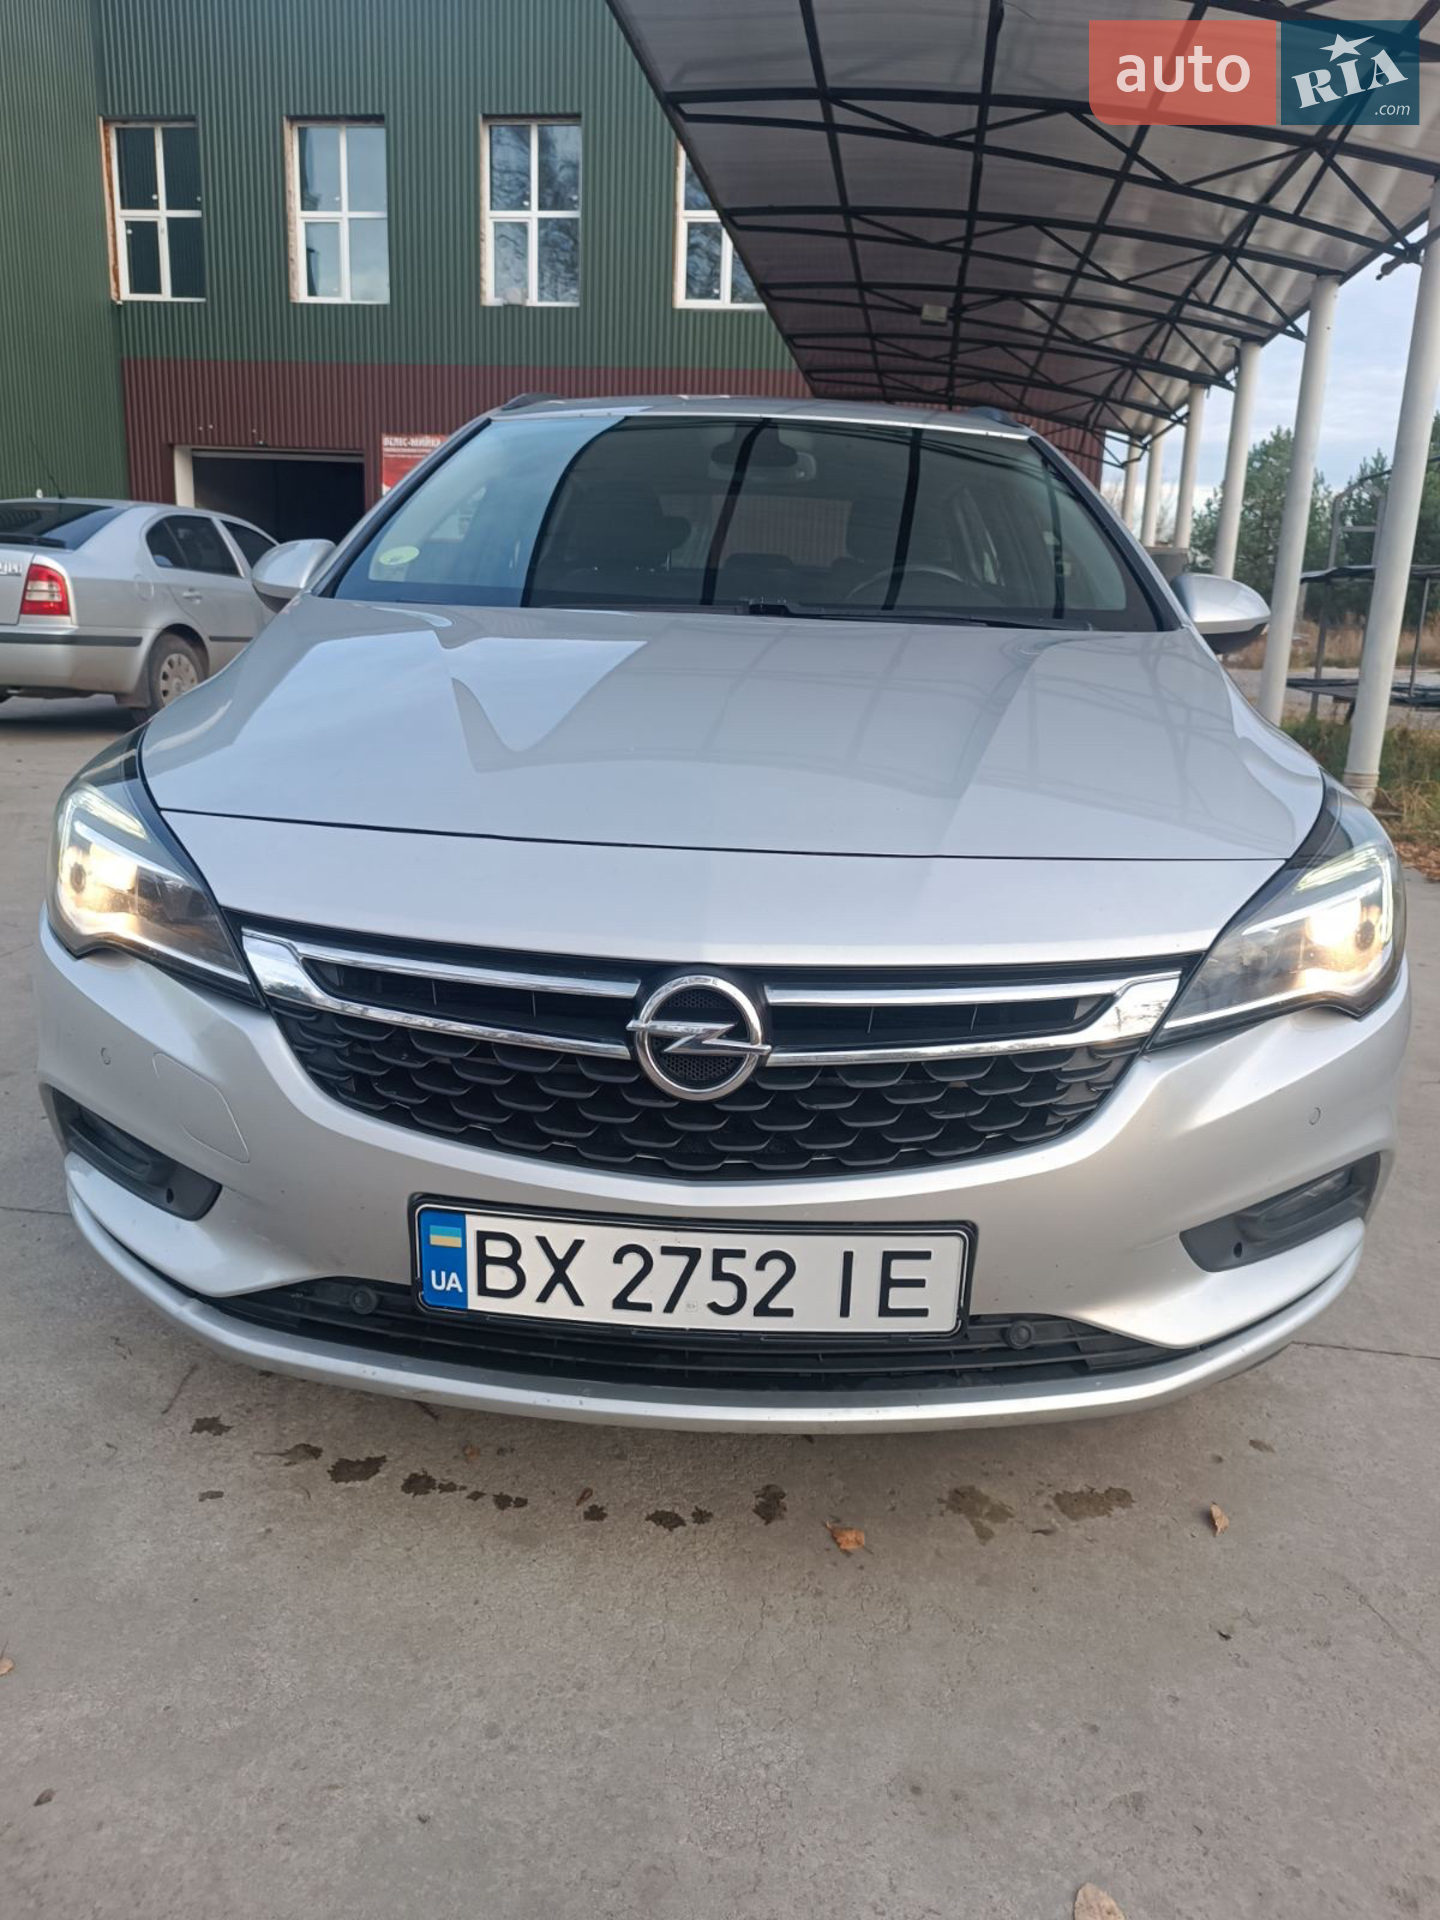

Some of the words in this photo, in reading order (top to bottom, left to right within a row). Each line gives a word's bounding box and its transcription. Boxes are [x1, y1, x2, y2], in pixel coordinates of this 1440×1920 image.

[431, 1269, 464, 1293] UA
[476, 1230, 585, 1307] BX
[612, 1243, 797, 1318] 2752
[839, 1250, 932, 1318] IE
